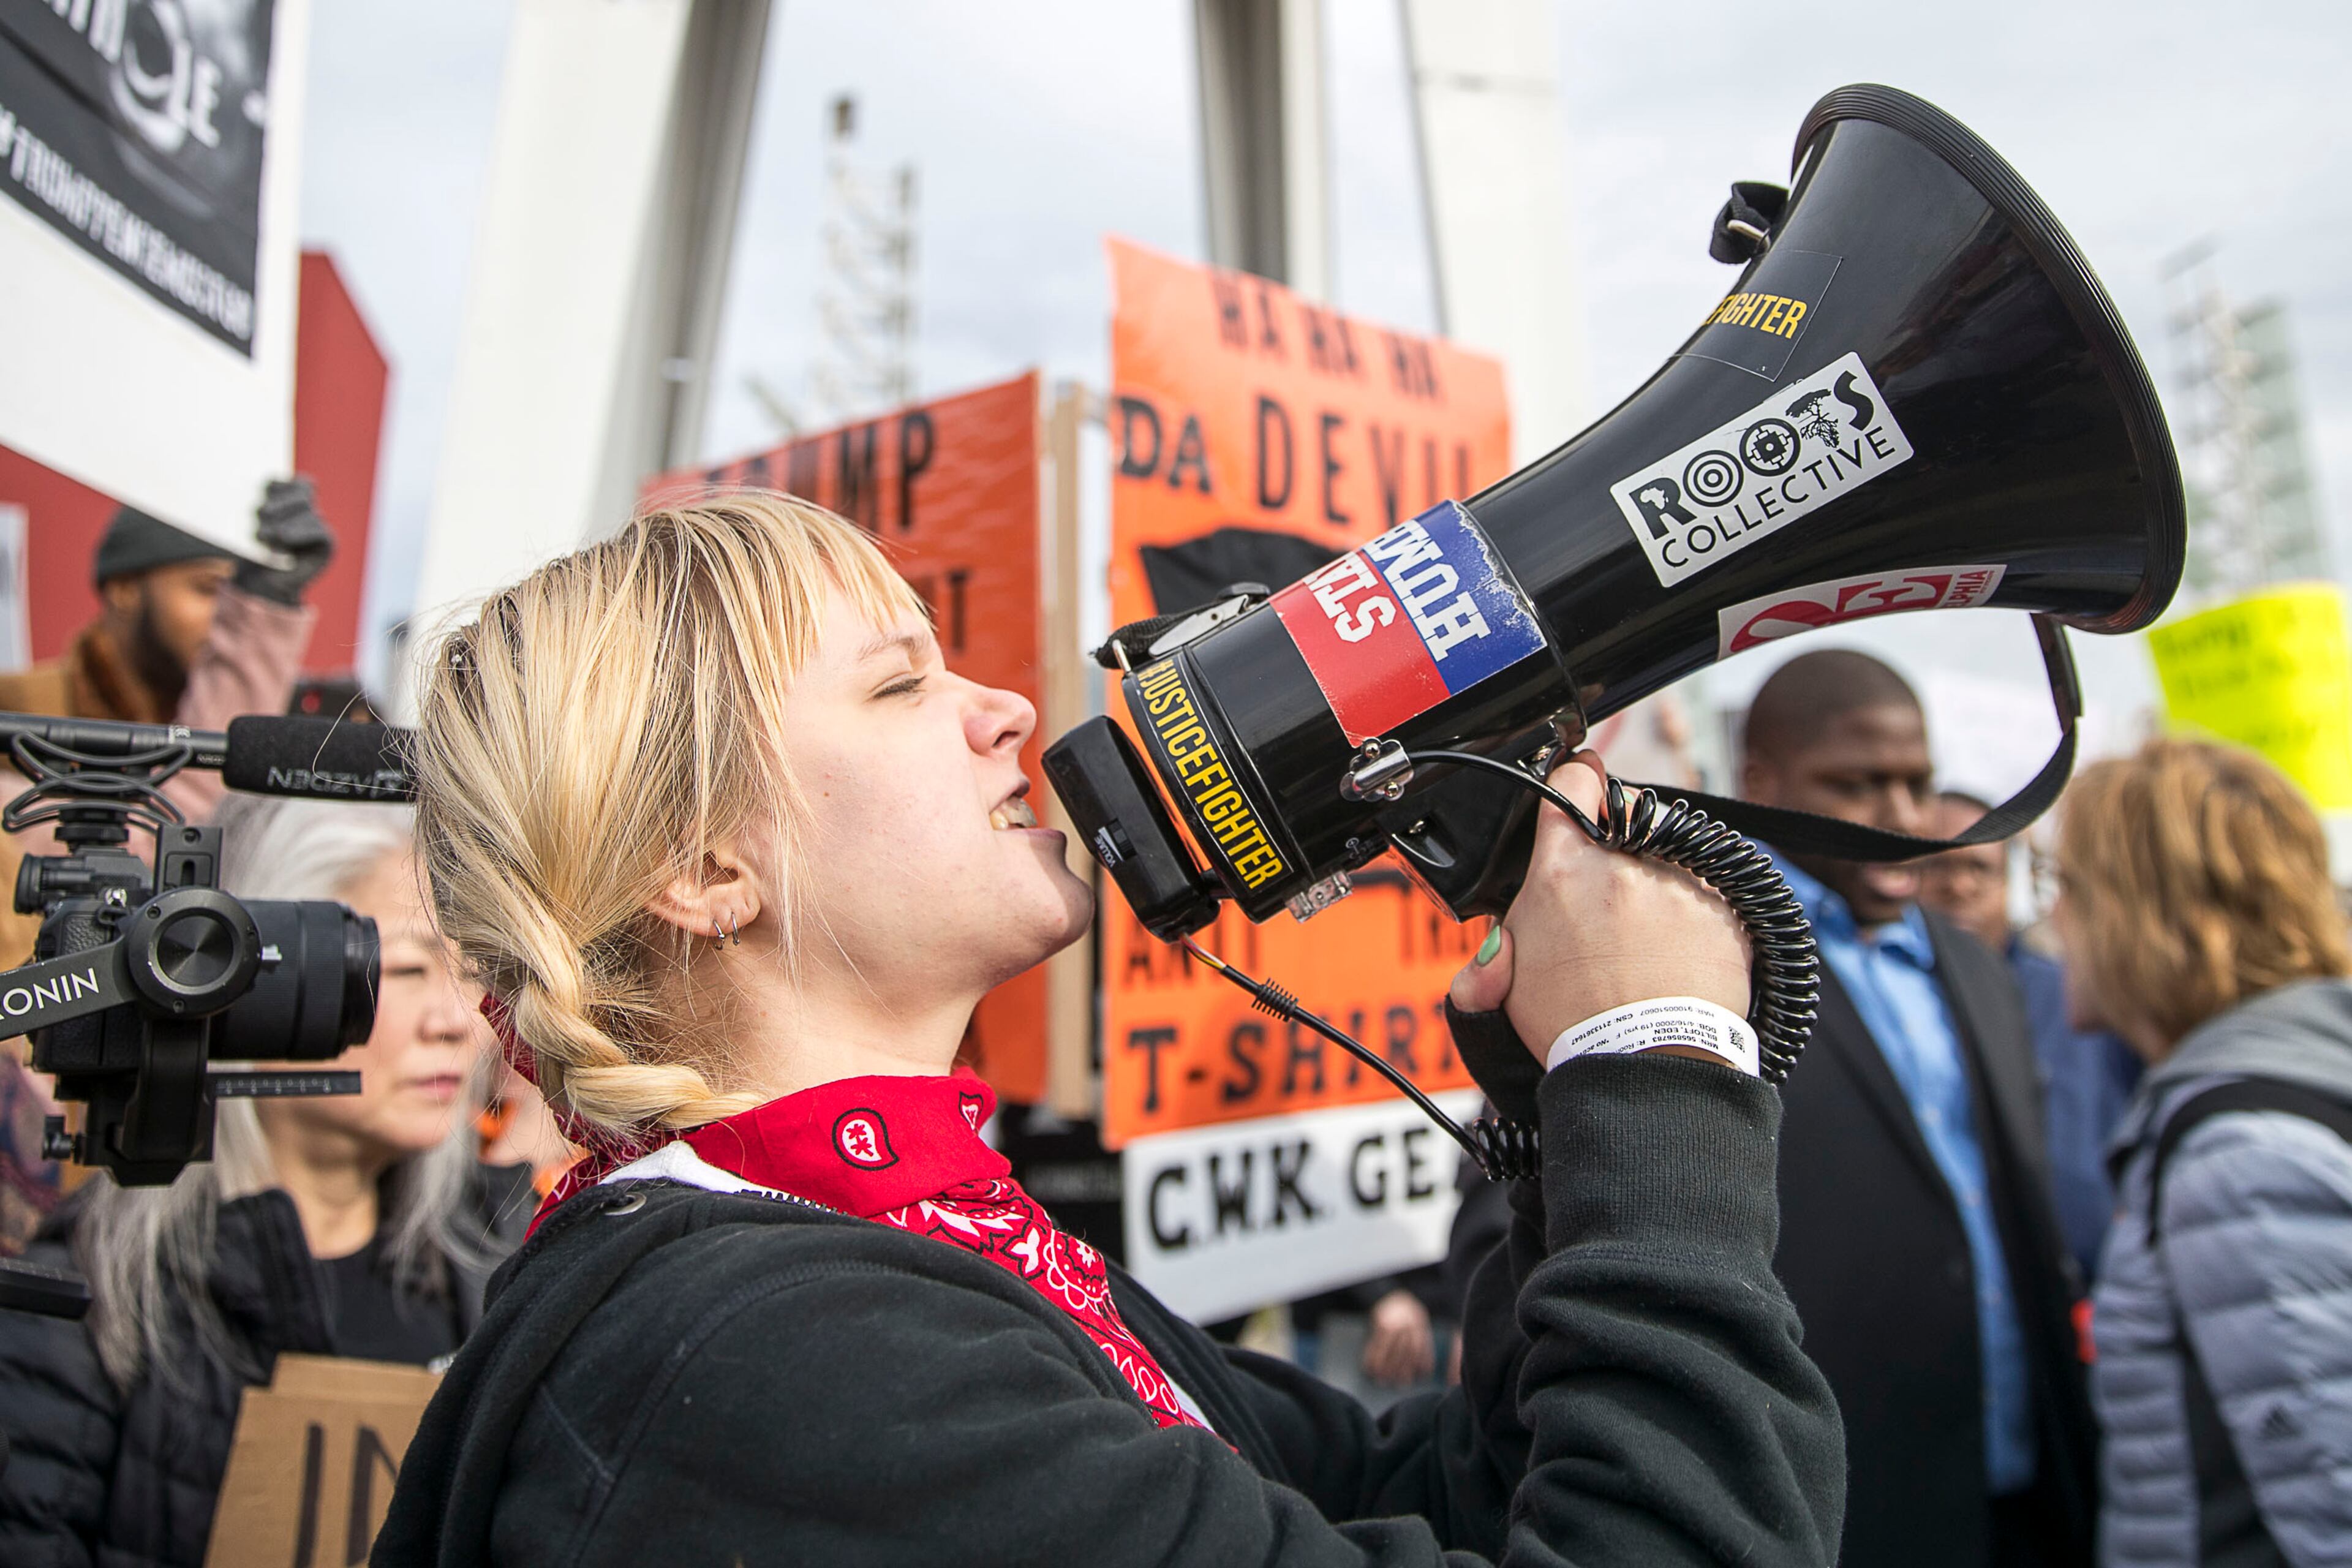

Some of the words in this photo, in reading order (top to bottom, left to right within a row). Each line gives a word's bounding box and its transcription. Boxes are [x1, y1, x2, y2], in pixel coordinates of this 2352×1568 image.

[1117, 393, 1212, 494] DA
[1662, 426, 1896, 567] COLLECTIVE
[1137, 658, 1283, 889] #JUSTICEFIGHTER
[1613, 1013, 1634, 1023] CSN:
[1697, 1023, 1717, 1034] DOB:
[1698, 1038, 1719, 1050] MRN:
[1149, 1140, 1318, 1251] CWK
[1351, 1128, 1434, 1208] GE
